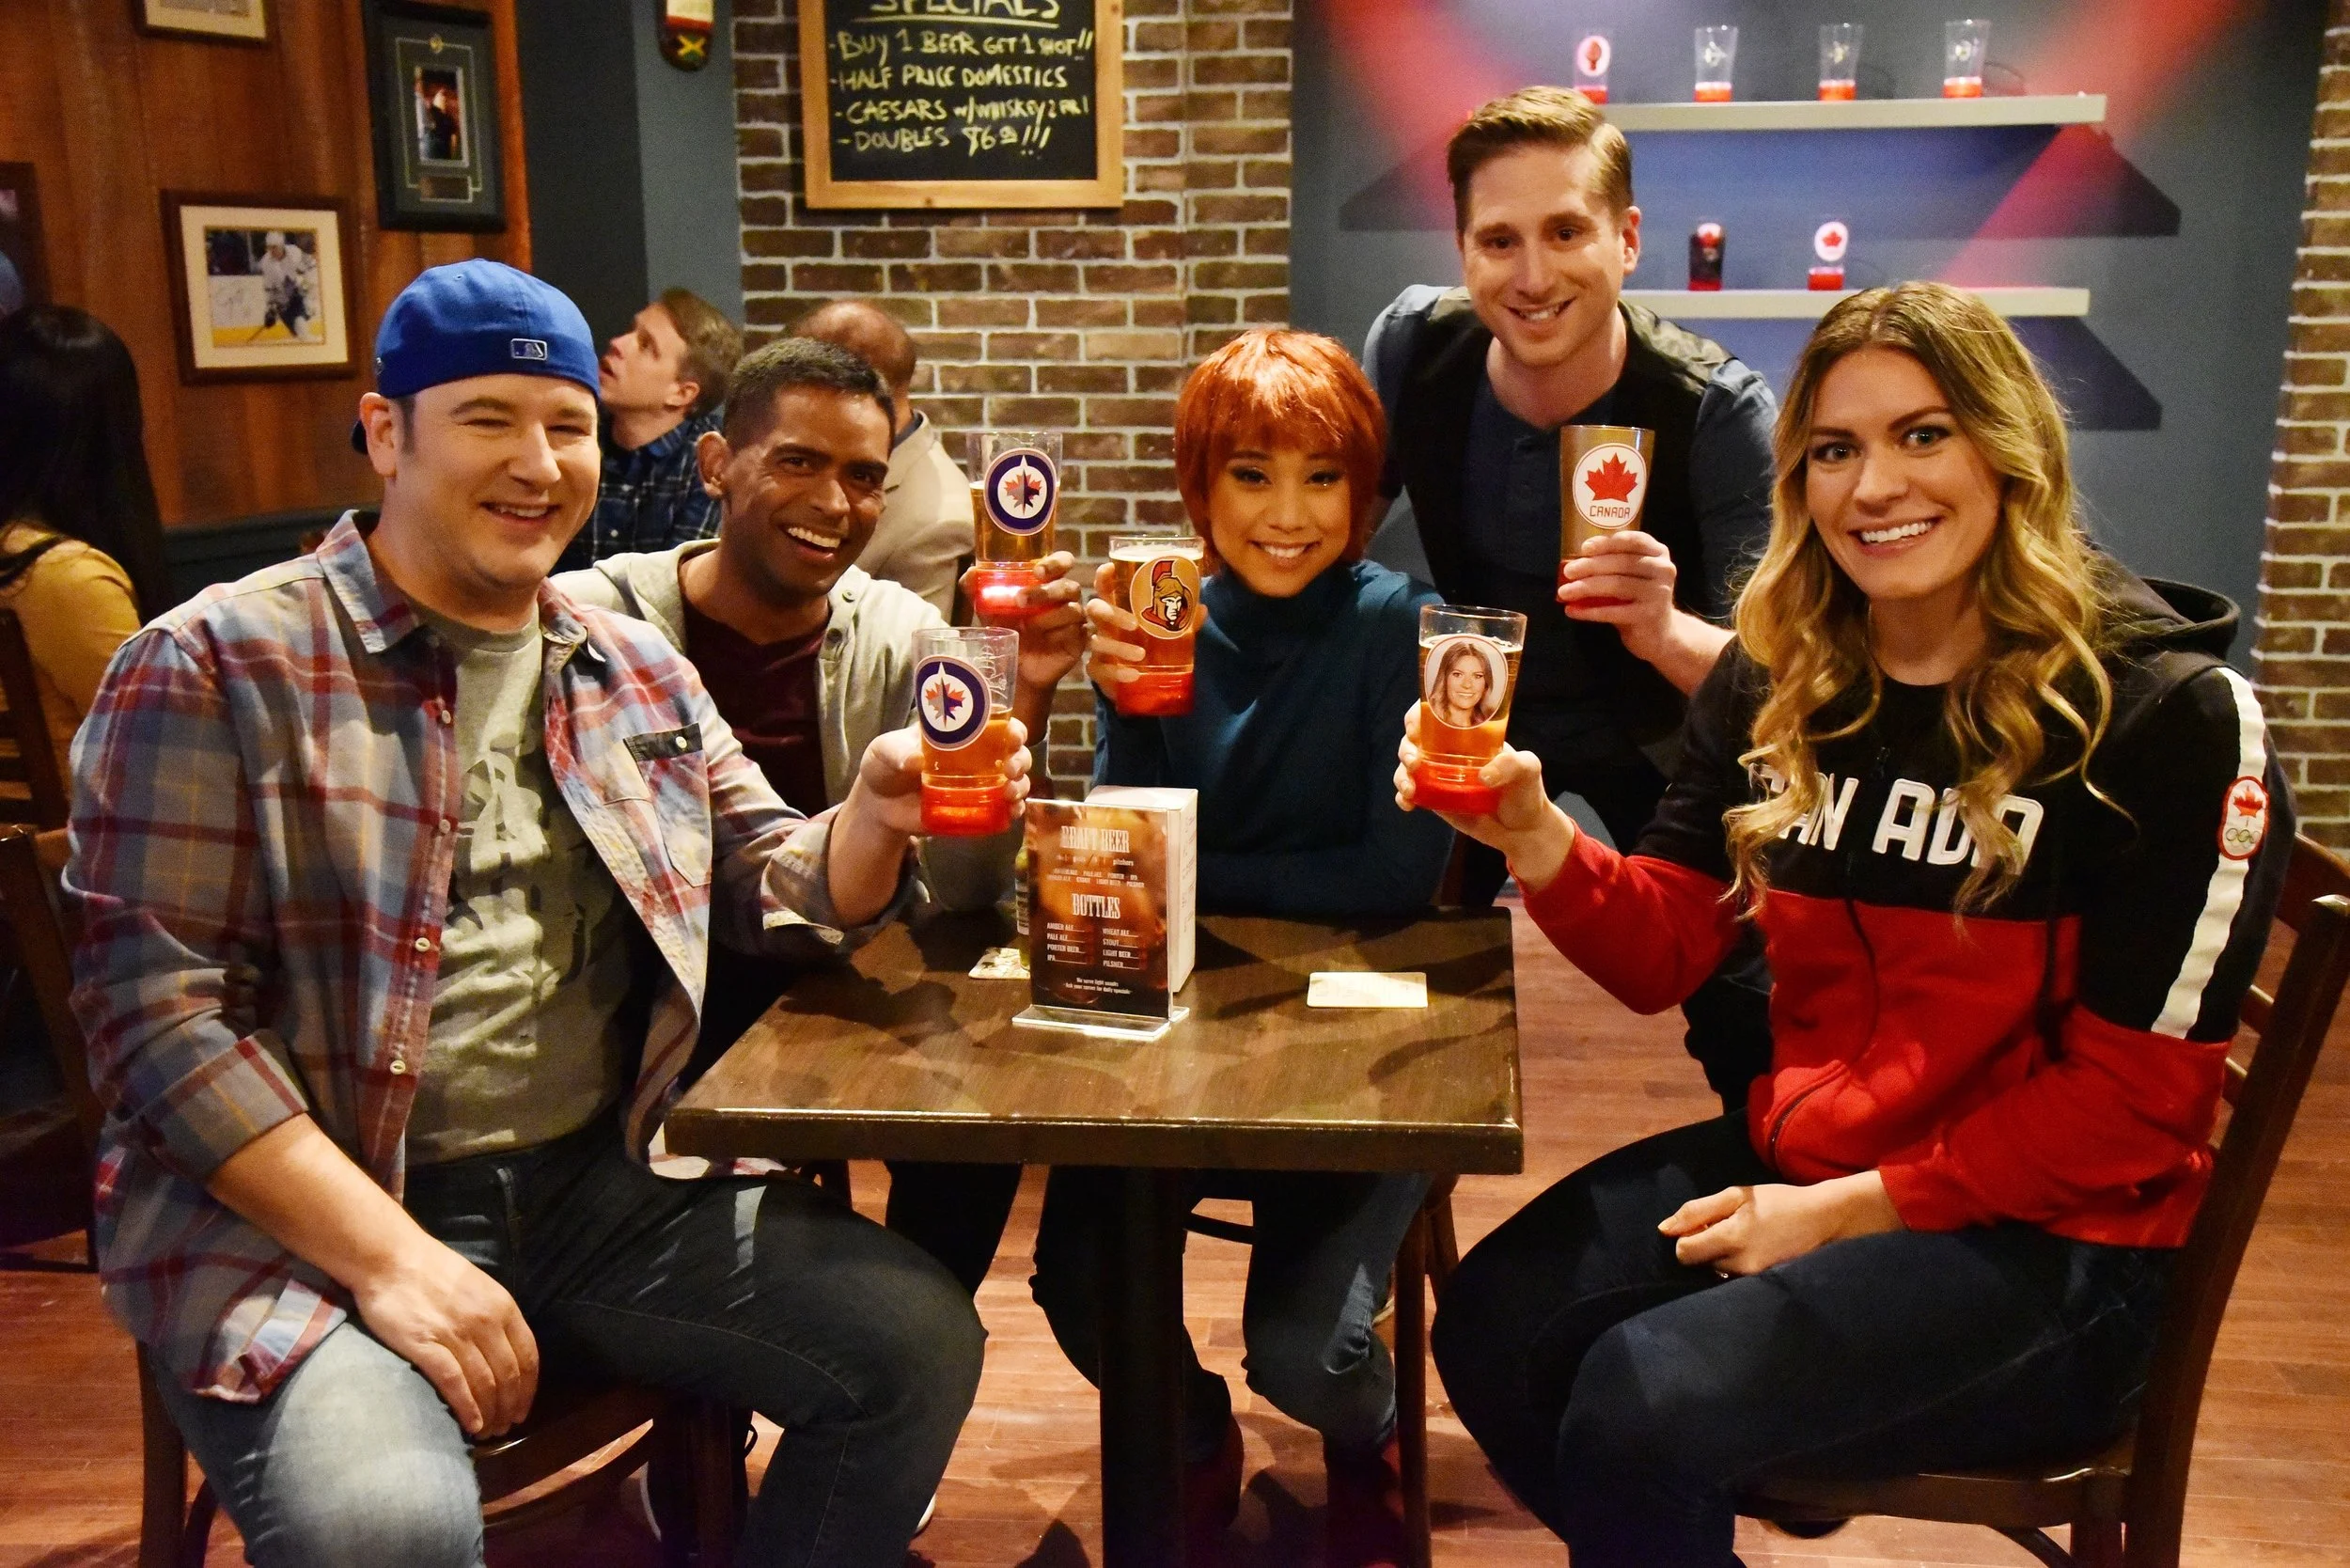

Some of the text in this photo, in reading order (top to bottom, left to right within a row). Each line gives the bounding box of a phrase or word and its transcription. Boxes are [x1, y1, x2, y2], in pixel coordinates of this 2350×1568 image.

[895, 28, 915, 53] 1
[920, 30, 980, 55] BEER
[983, 36, 1017, 55] GET
[1021, 33, 1035, 54] 1
[901, 64, 955, 87] PRICE
[962, 64, 1069, 88] DOMESTICS
[1590, 505, 1631, 519] CANADA
[1072, 893, 1121, 919] BOTTLES
